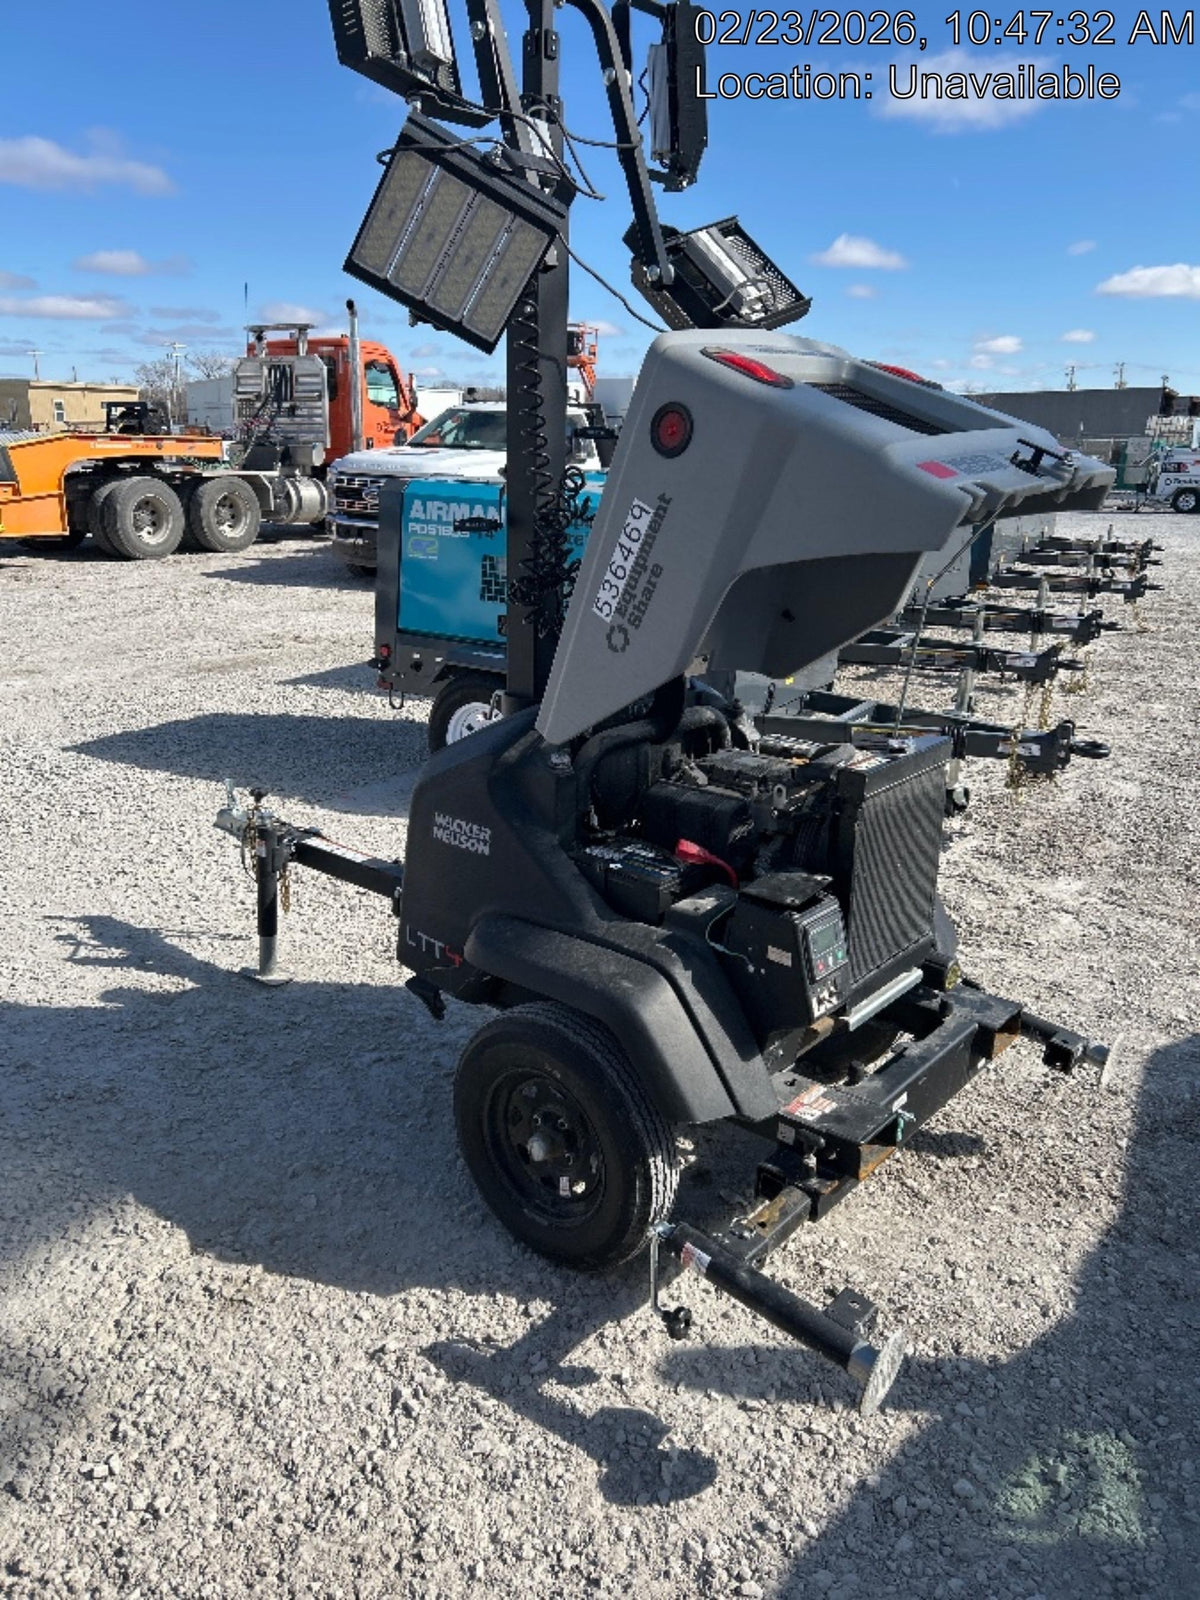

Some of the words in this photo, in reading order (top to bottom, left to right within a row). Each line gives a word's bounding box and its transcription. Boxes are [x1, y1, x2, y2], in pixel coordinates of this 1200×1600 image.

[409, 499, 506, 525] AIRMAN
[594, 504, 651, 618] 536469
[614, 492, 673, 619] Equipment
[627, 562, 664, 630] Share
[433, 826, 490, 856] NEUSON
